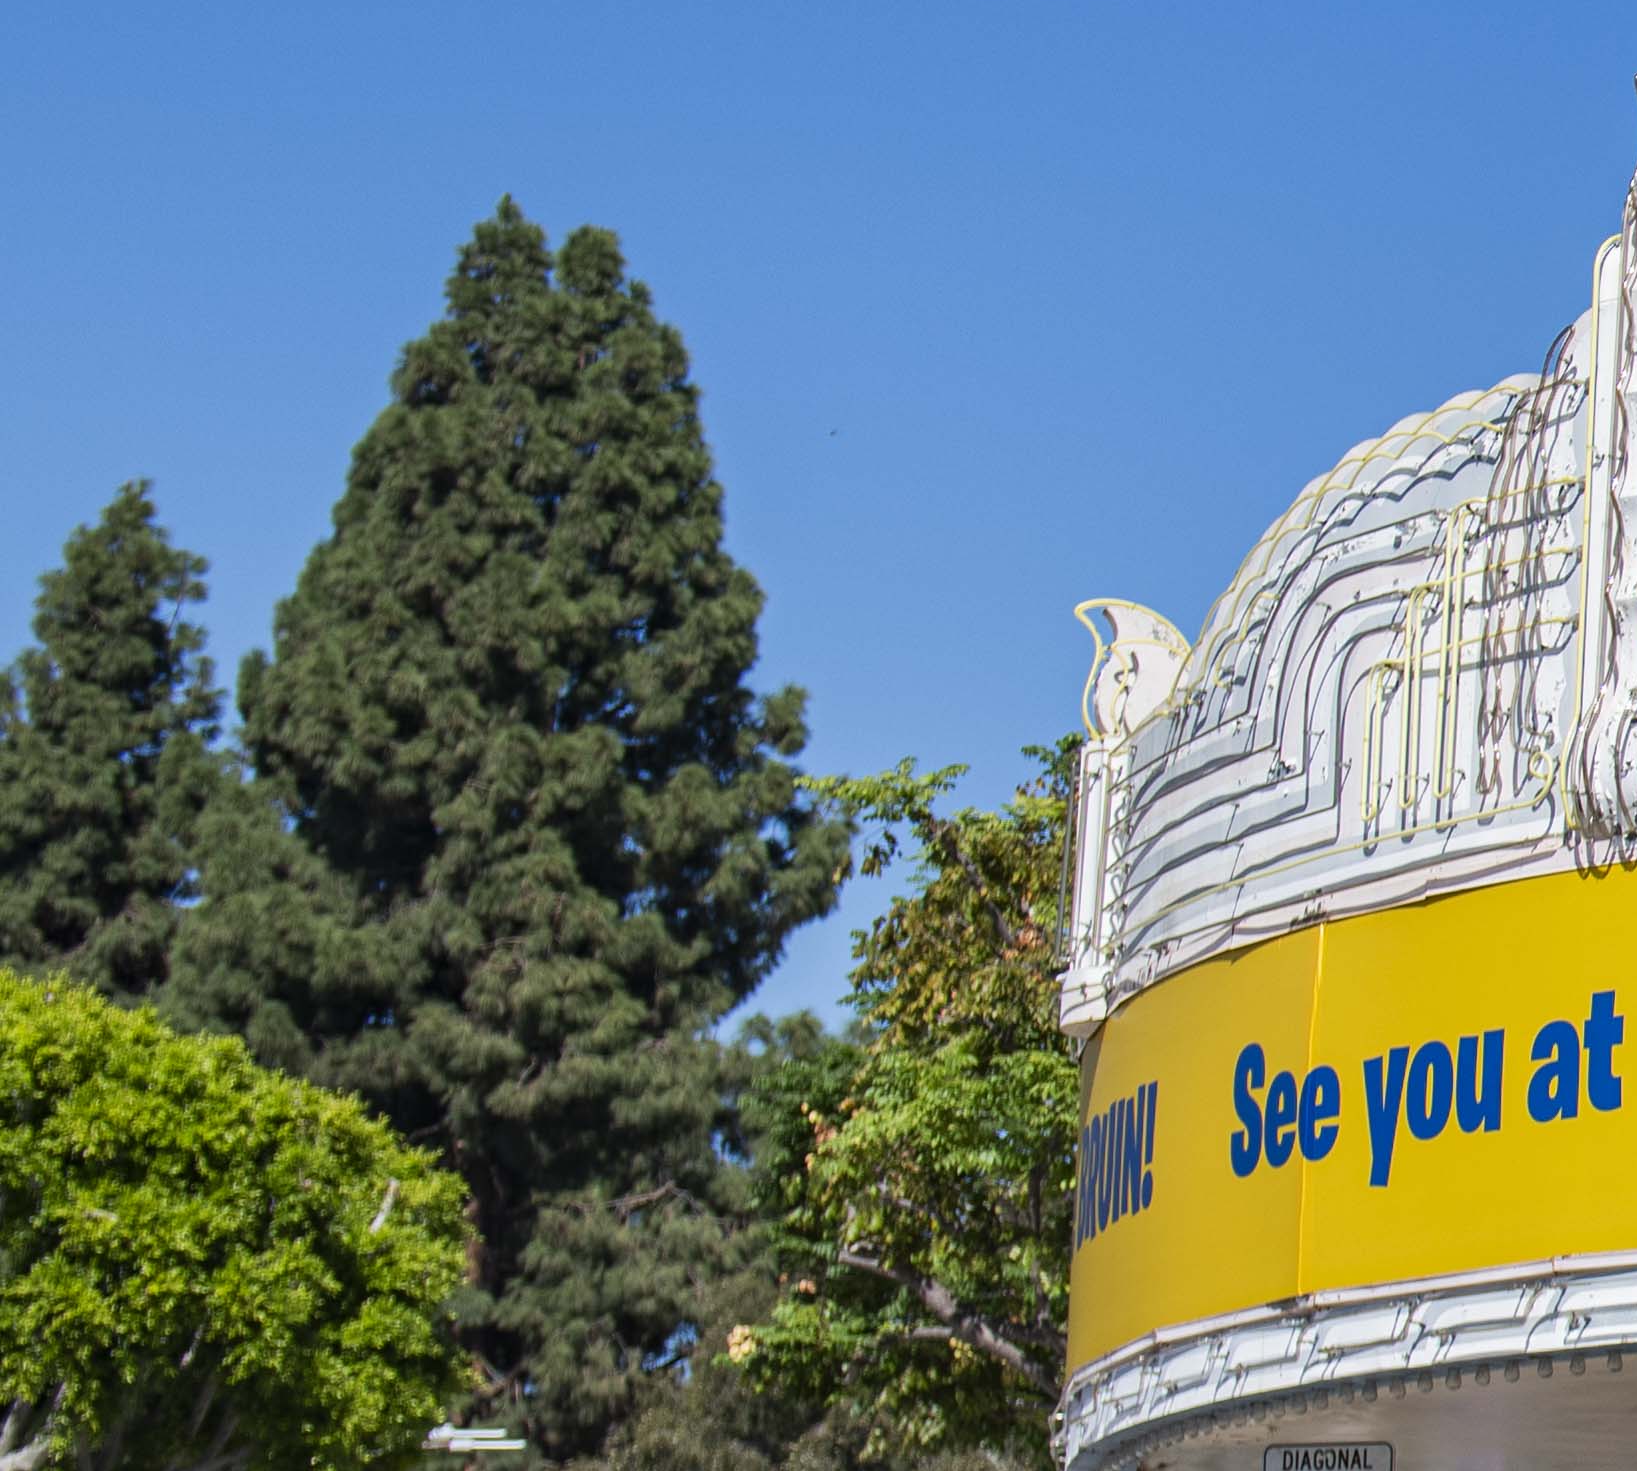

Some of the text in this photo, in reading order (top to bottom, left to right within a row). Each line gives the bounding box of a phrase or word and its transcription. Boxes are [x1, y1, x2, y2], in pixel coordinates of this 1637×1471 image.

[1230, 1043, 1340, 1178] See
[1363, 1029, 1505, 1188] you
[1527, 989, 1625, 1123] at
[1282, 1448, 1373, 1471] DIAGONAL
